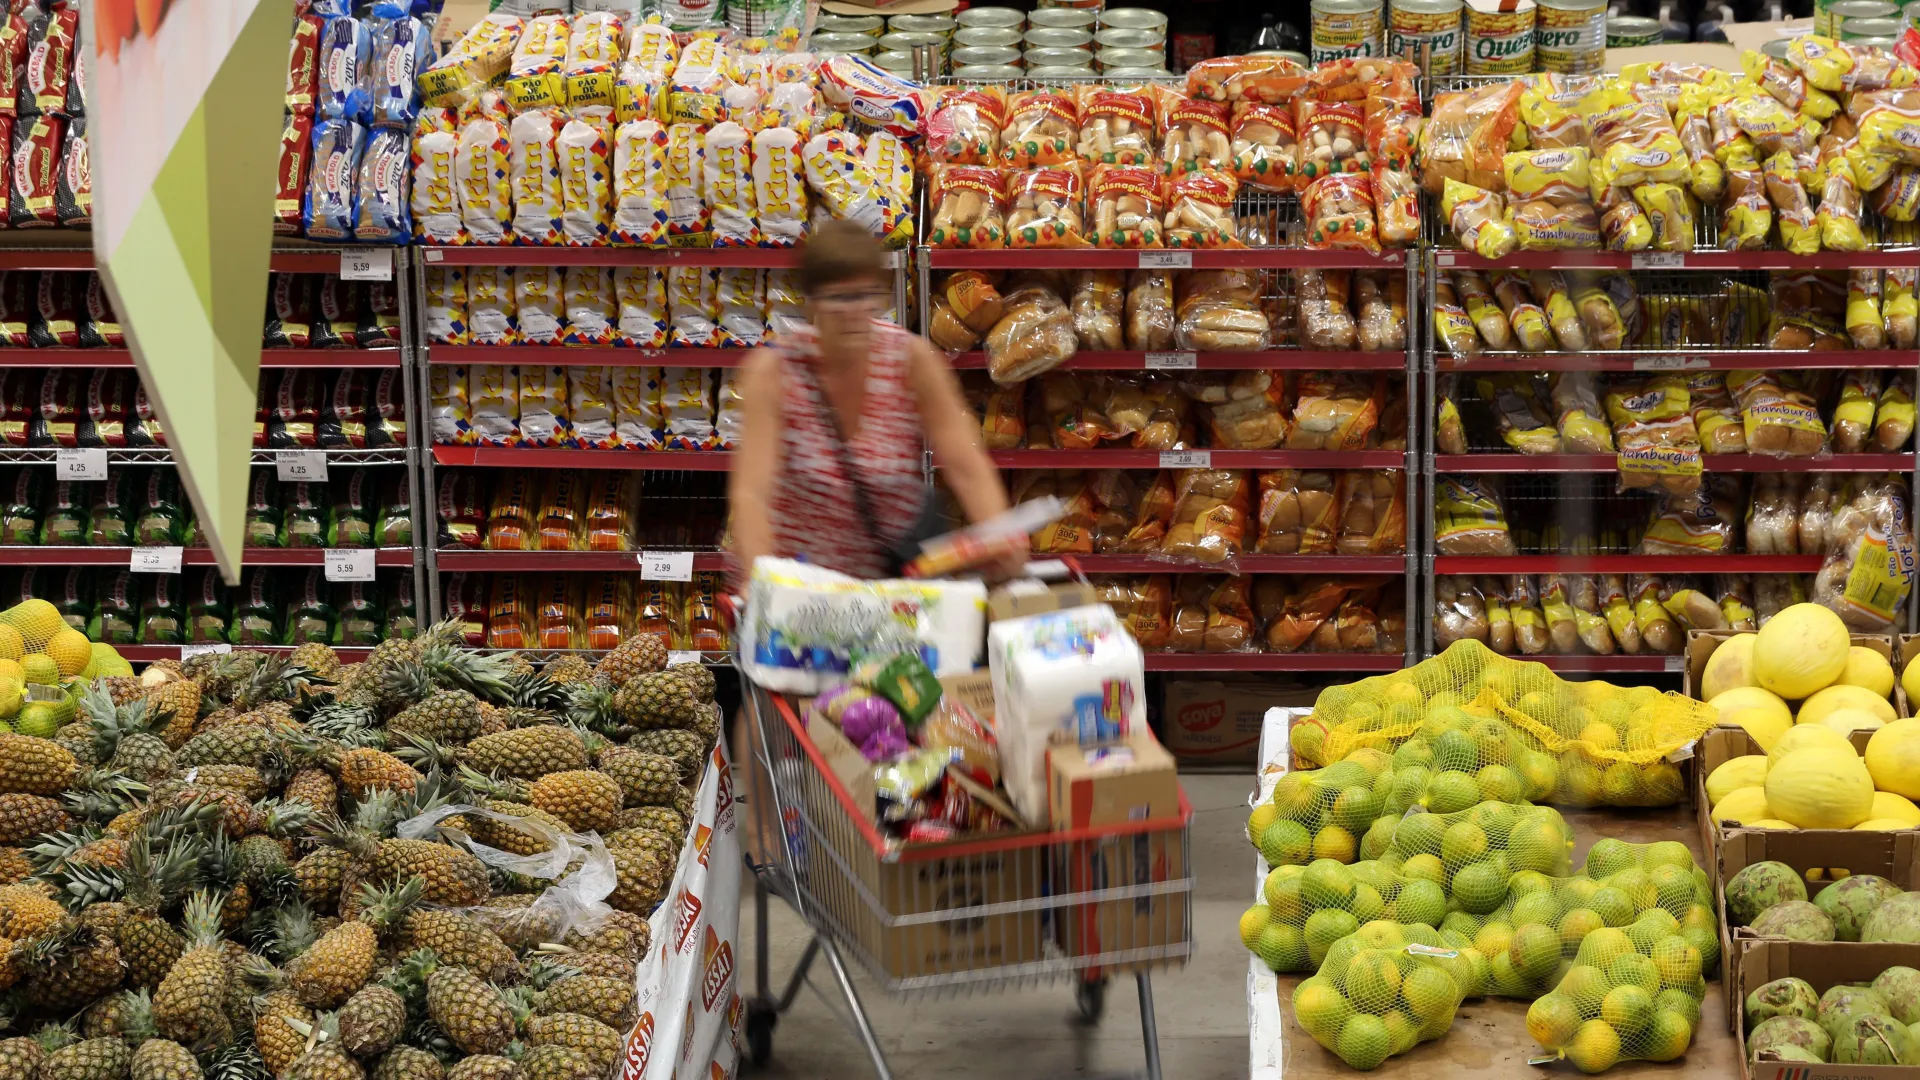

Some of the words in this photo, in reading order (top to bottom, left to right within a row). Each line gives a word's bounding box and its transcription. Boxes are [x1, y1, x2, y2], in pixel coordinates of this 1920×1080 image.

[1535, 30, 1581, 48] uero
[31, 46, 45, 90] WICKBOLD
[345, 57, 355, 87] zero
[389, 46, 400, 83] WICKBOLD
[1488, 63, 1513, 73] Milho
[430, 73, 447, 83] PÃO
[522, 78, 542, 88] PÃO
[577, 78, 598, 88] PÃO
[430, 85, 458, 98] FORMA
[517, 91, 550, 105] FORMA
[573, 90, 607, 102] FORMA
[582, 85, 596, 93] DE
[287, 153, 299, 190] Tradicional
[329, 154, 340, 190] WICKBOLD
[377, 154, 391, 189] WICKBOLD
[390, 161, 402, 190] zero
[464, 145, 490, 209] Kim
[519, 141, 543, 205] Kim
[566, 146, 589, 211] Kim
[711, 146, 738, 211] Kim
[764, 146, 790, 213] Kim
[427, 152, 452, 214] Kim
[307, 228, 344, 237] WICKBOLD
[355, 228, 390, 236] WICKBOLD
[353, 262, 370, 272] 5,59
[69, 463, 86, 472] 4,25
[1057, 529, 1080, 542] 300g
[337, 564, 354, 573] 5,59
[654, 563, 671, 573] 2,99
[1888, 556, 1897, 578] Pão
[1900, 545, 1914, 585] Hot
[1139, 620, 1160, 631] 300g
[1181, 704, 1222, 726] soya
